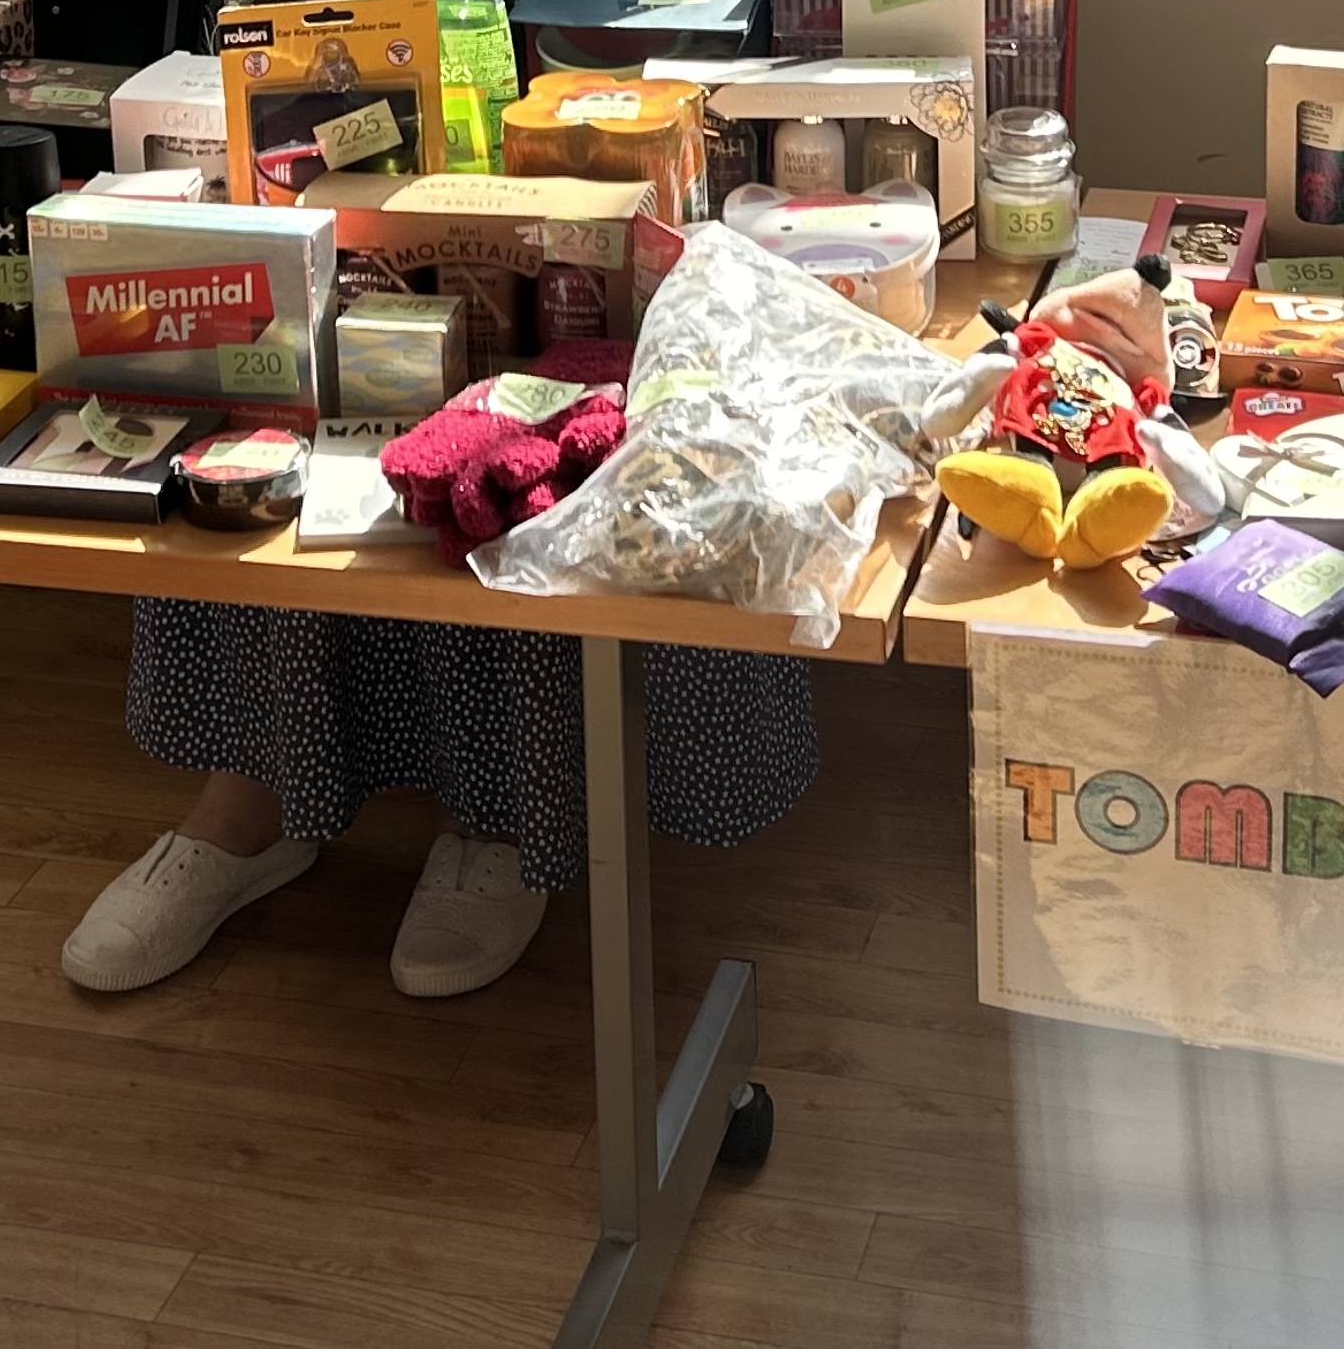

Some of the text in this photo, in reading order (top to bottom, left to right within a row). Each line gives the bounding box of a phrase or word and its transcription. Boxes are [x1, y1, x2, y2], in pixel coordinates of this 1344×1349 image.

[223, 27, 268, 45] rolson
[331, 111, 383, 146] 225
[447, 224, 482, 238] Mini
[1008, 211, 1055, 234] 355
[559, 224, 610, 251] 275
[397, 239, 537, 272] MOCKTAILS
[1284, 262, 1335, 282] 365
[85, 271, 253, 315] Millennial
[153, 312, 197, 343] AF
[233, 351, 282, 376] 230
